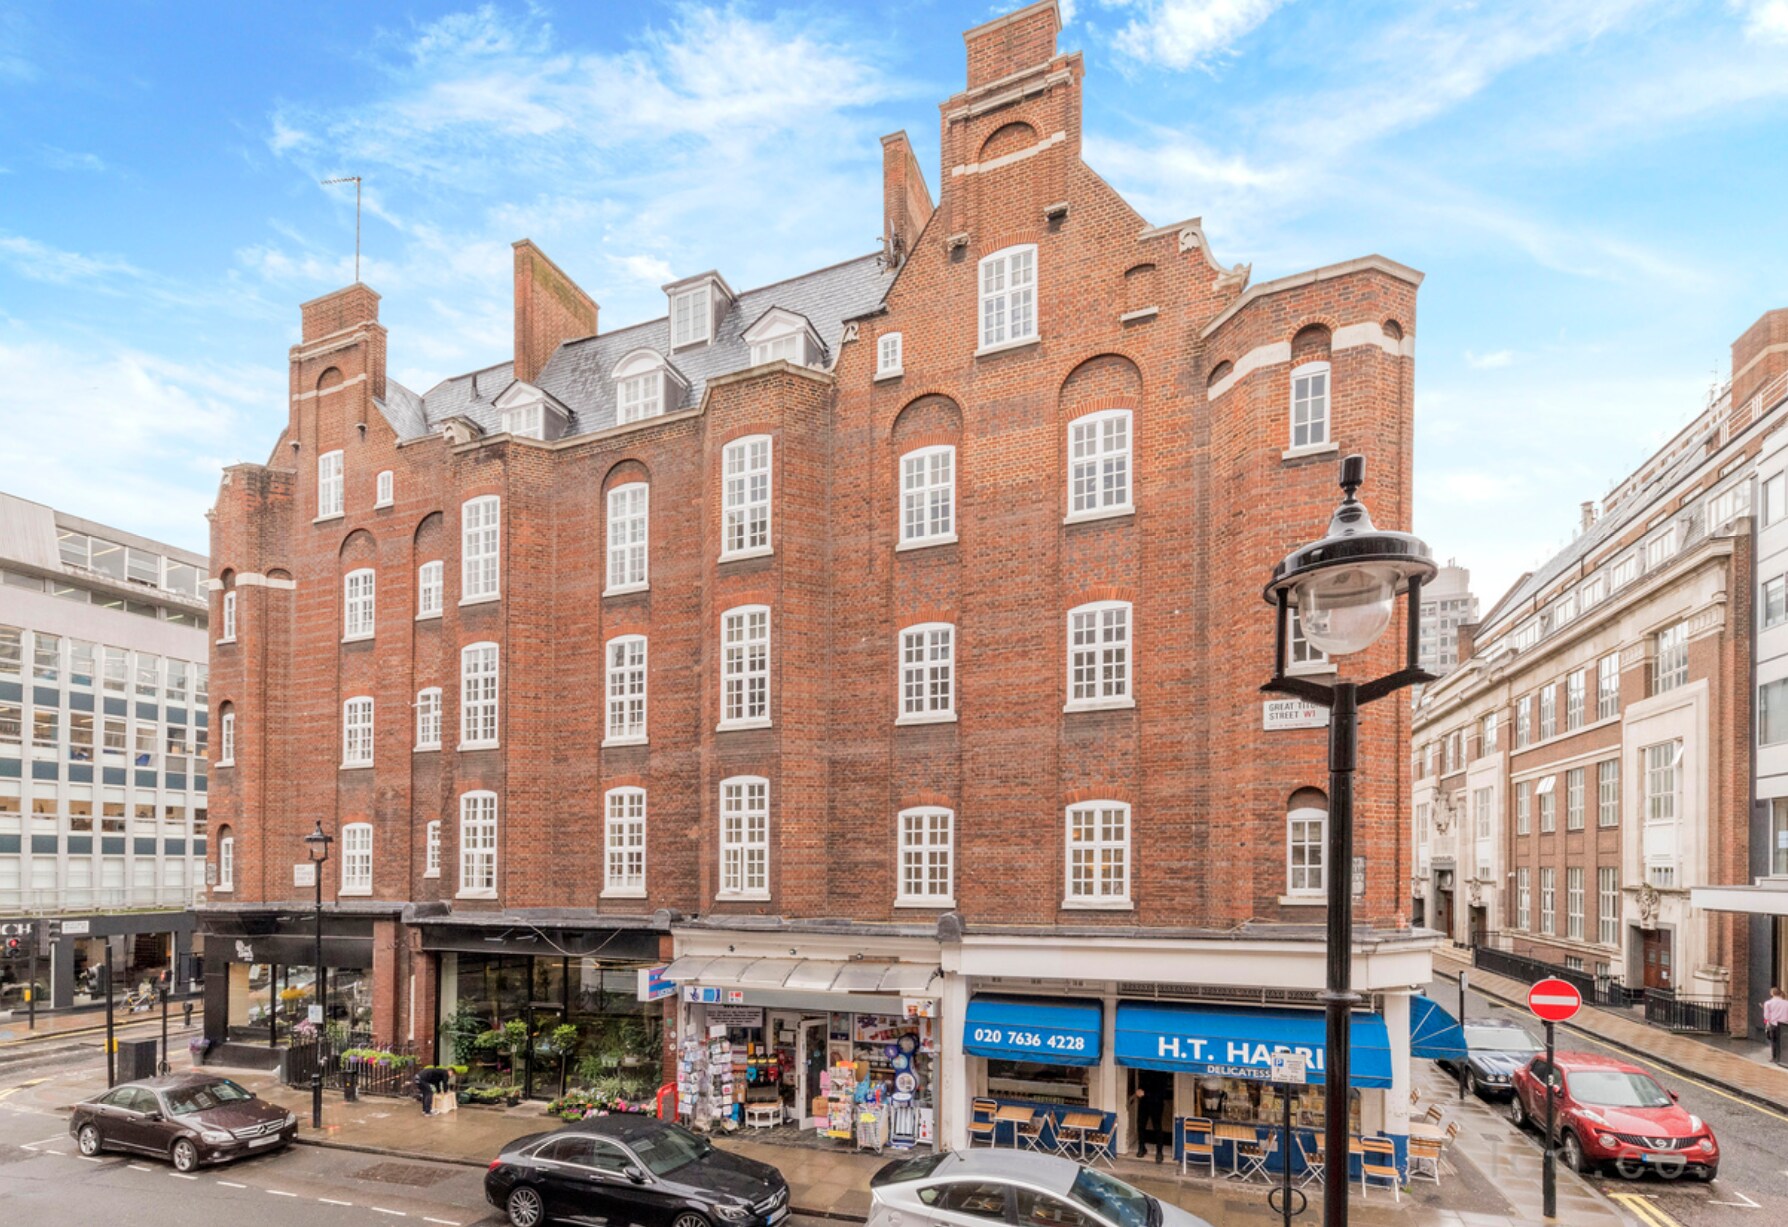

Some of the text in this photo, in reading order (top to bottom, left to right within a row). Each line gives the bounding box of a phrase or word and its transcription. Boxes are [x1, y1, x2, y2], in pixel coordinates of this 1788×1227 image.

[1269, 703, 1294, 711] GREAT
[1269, 711, 1298, 720] STREET
[974, 1028, 1085, 1050] 020 7636 4228
[1158, 1036, 1214, 1061] H.T.
